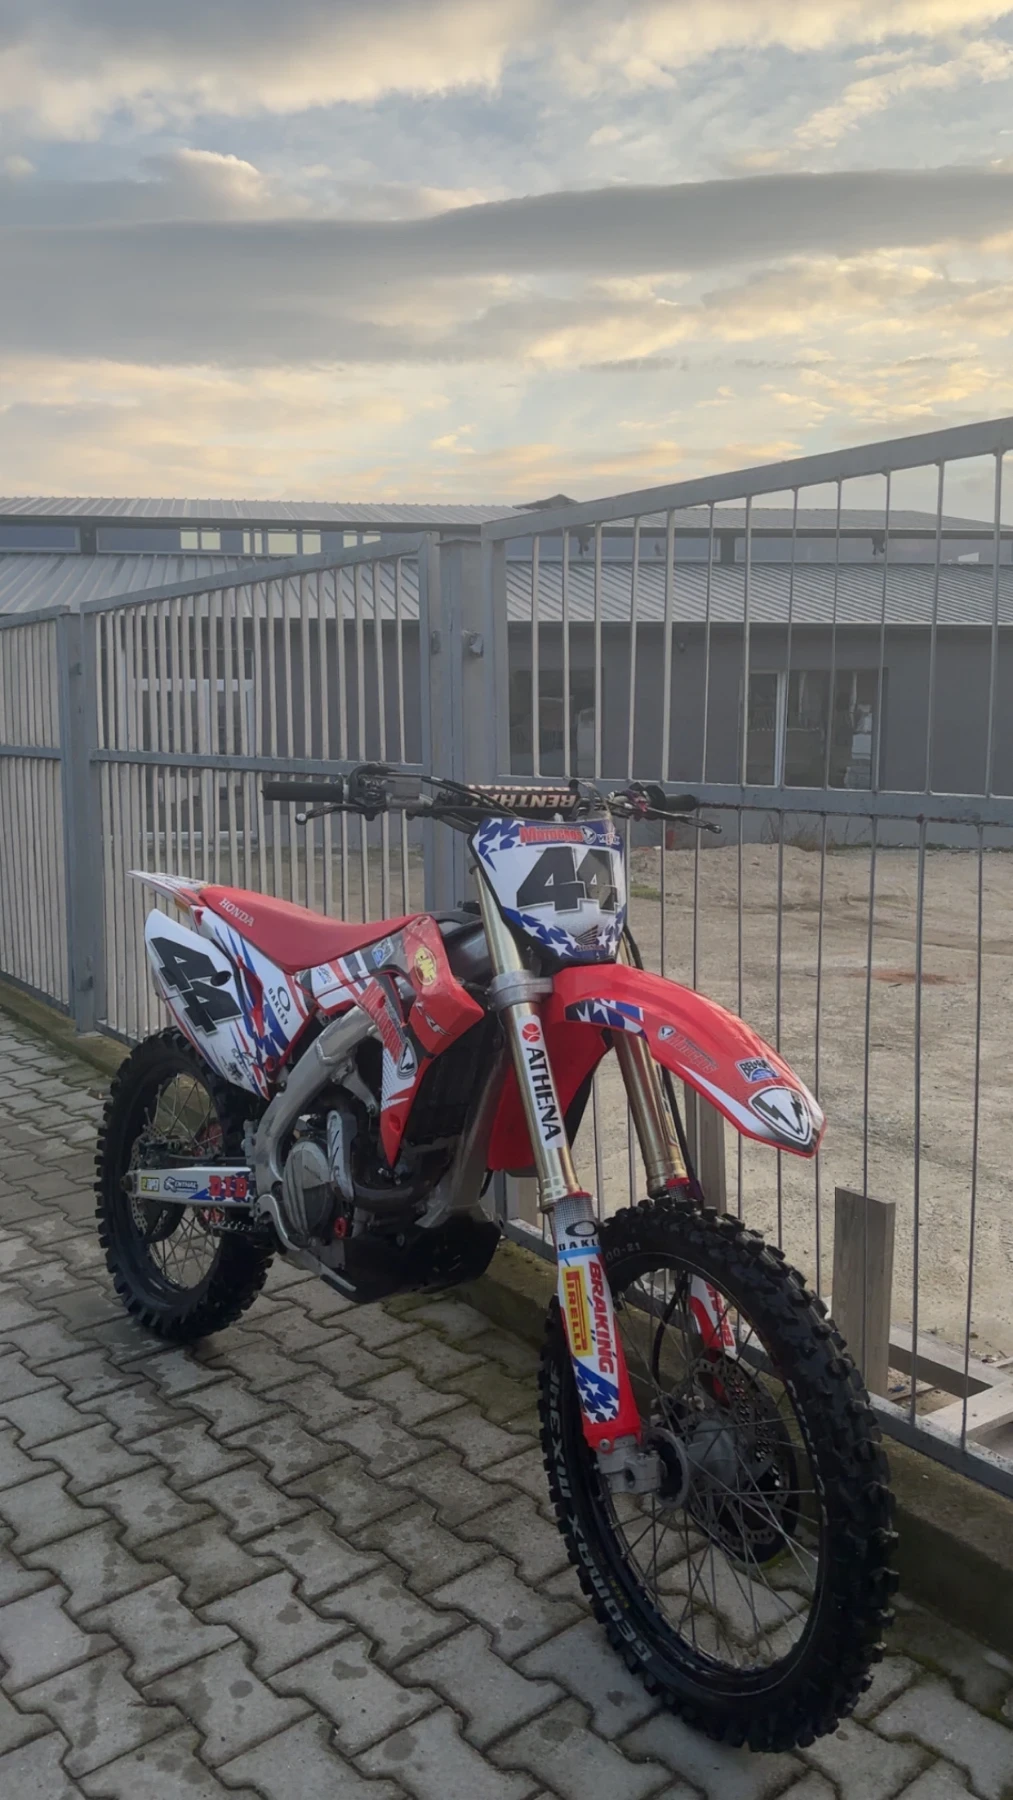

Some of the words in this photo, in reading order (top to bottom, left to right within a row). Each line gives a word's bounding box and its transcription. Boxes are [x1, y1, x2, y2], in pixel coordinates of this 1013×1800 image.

[218, 897, 255, 927] HONDA
[516, 846, 620, 914] 44
[150, 936, 244, 1036] 44
[268, 987, 289, 1026] OAKLEY
[526, 1047, 562, 1142] ATHENA
[558, 1238, 599, 1251] OAKL
[566, 1270, 588, 1351] PIRELLI
[588, 1261, 616, 1375] BRAKING
[566, 1513, 653, 1662] GEOMAX
